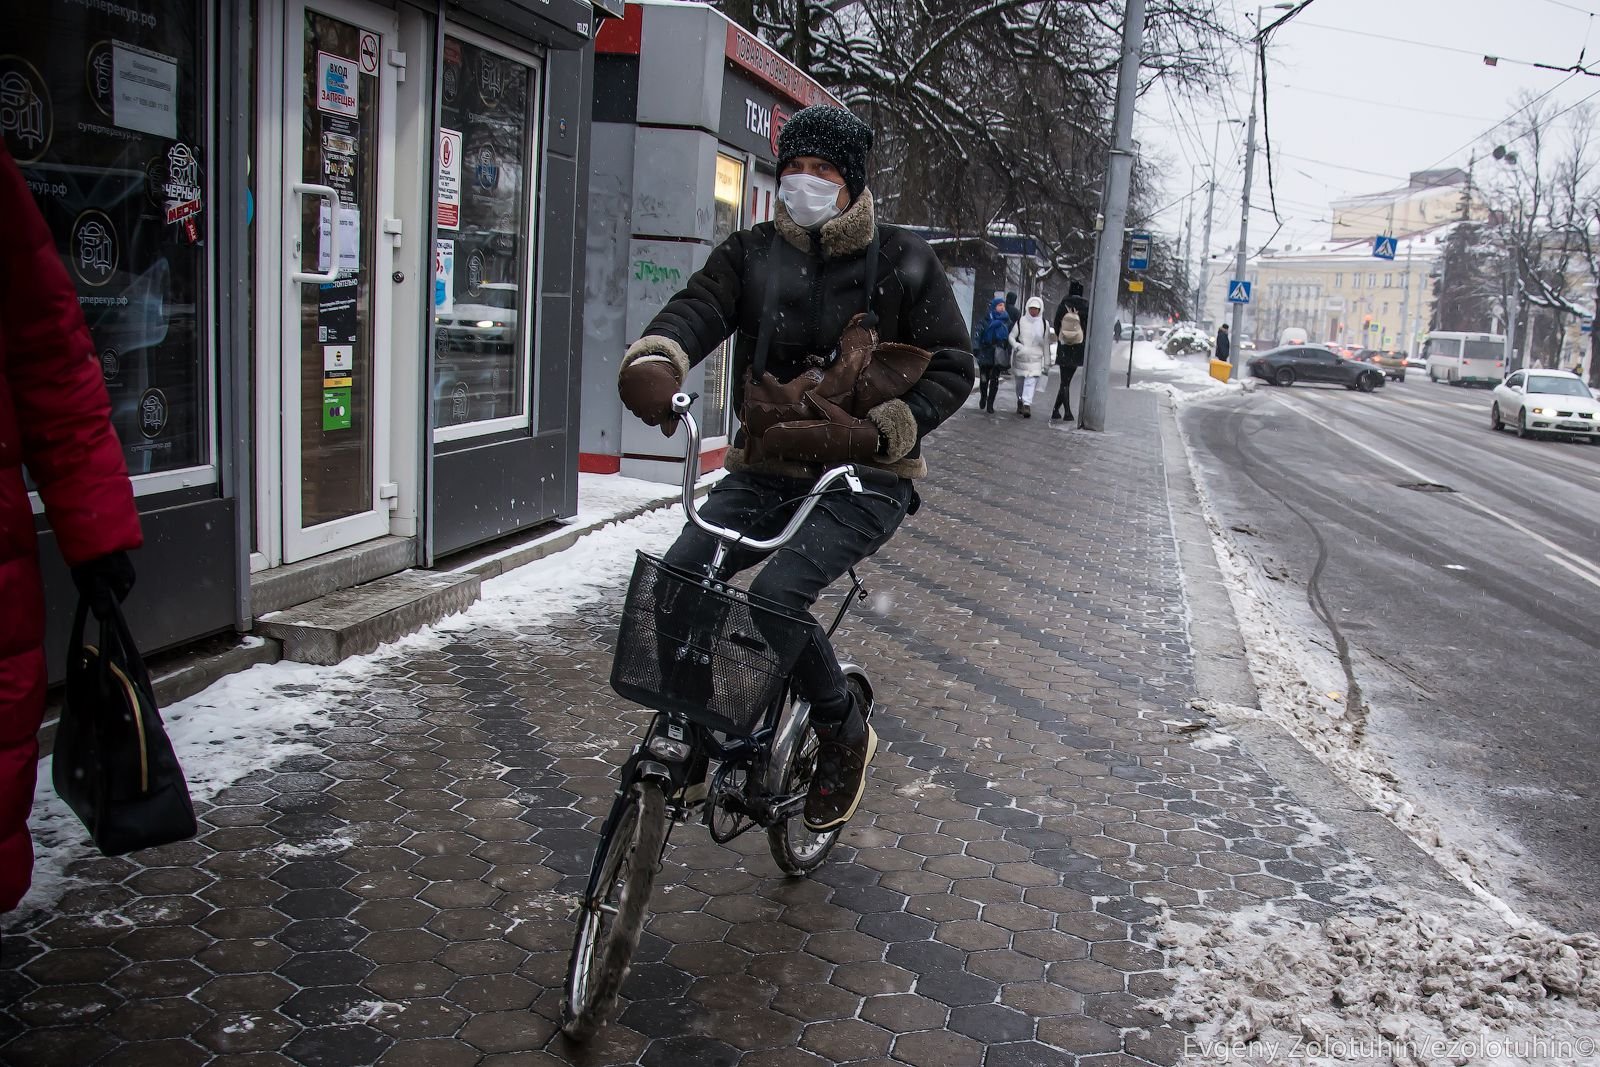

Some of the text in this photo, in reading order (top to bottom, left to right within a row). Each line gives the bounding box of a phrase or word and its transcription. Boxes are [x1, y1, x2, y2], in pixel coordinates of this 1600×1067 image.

[64, 0, 158, 29] ерперекур.рф
[330, 63, 348, 79] ВХОД
[321, 90, 355, 107] ЗАПРЕЩЕН
